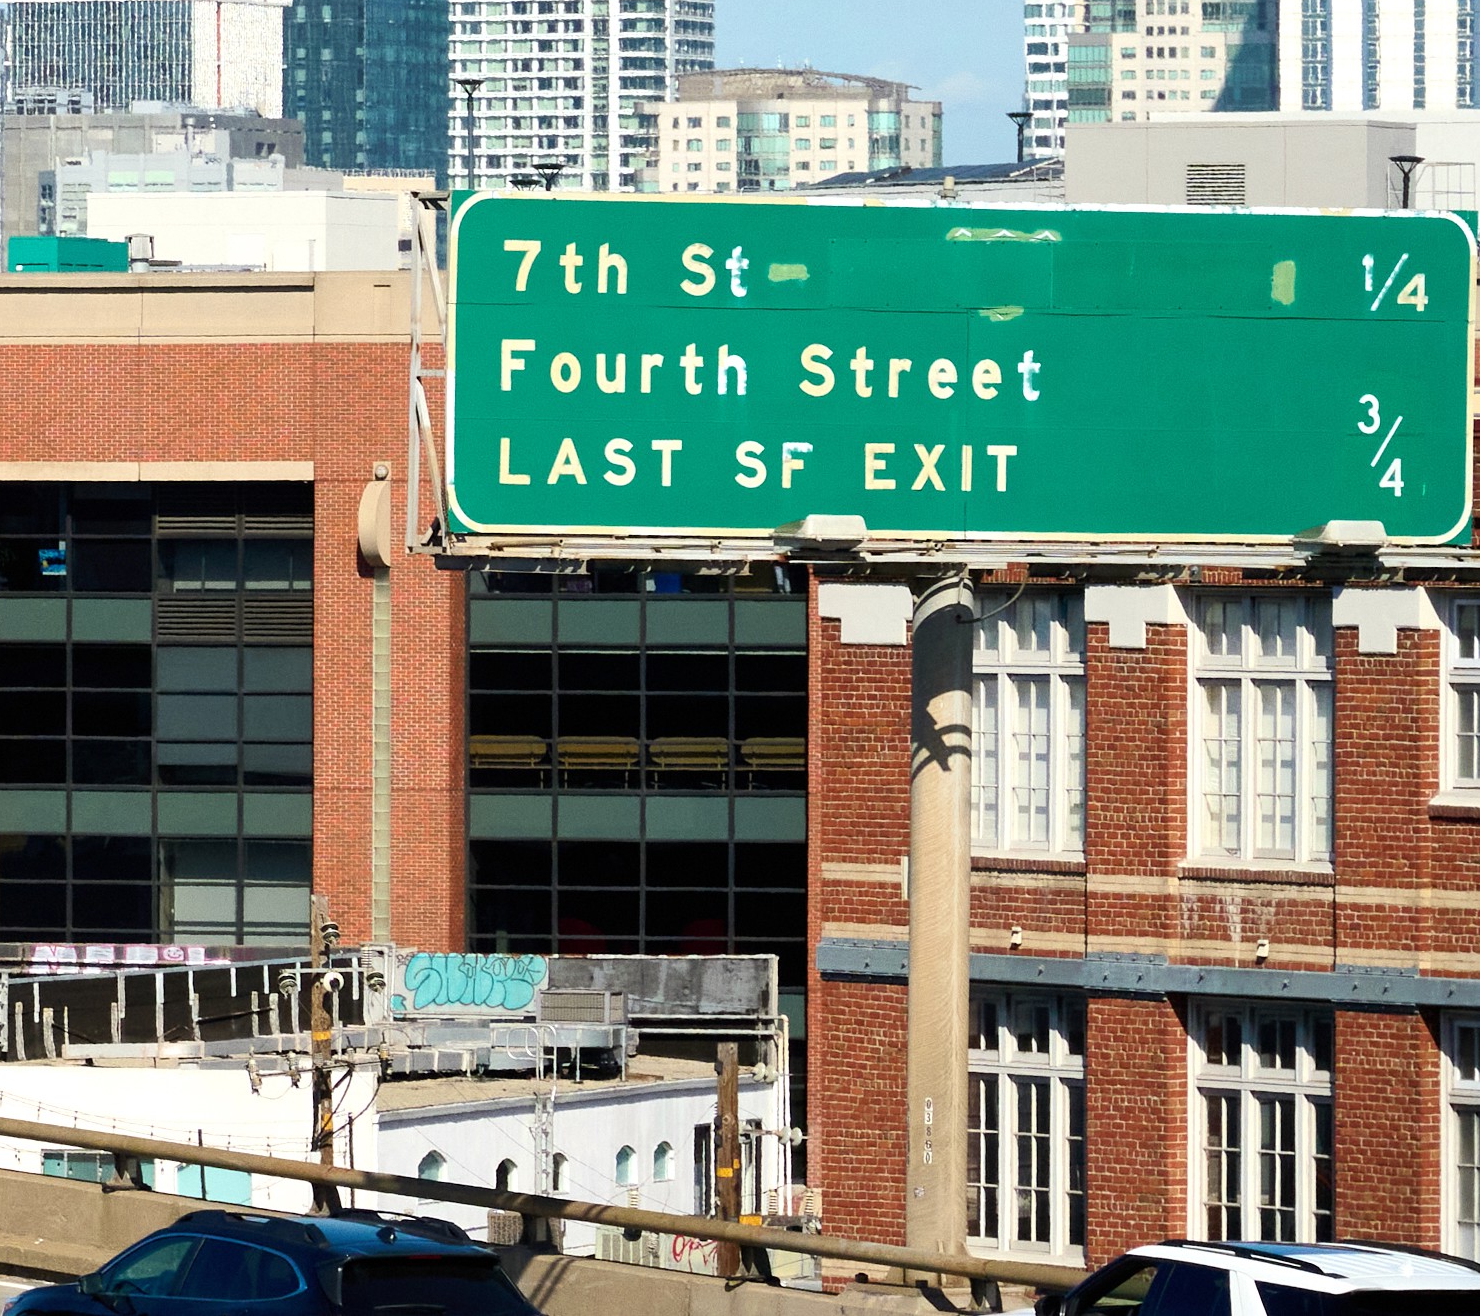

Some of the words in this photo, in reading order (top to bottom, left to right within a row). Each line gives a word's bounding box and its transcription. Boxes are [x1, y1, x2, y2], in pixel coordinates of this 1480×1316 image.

[502, 239, 629, 295] 7th
[680, 243, 750, 298] St
[499, 338, 748, 396] Fourth
[799, 343, 1042, 402] Street
[499, 437, 683, 487] LAST
[734, 440, 814, 489] SF
[863, 442, 1019, 492] EXIT
